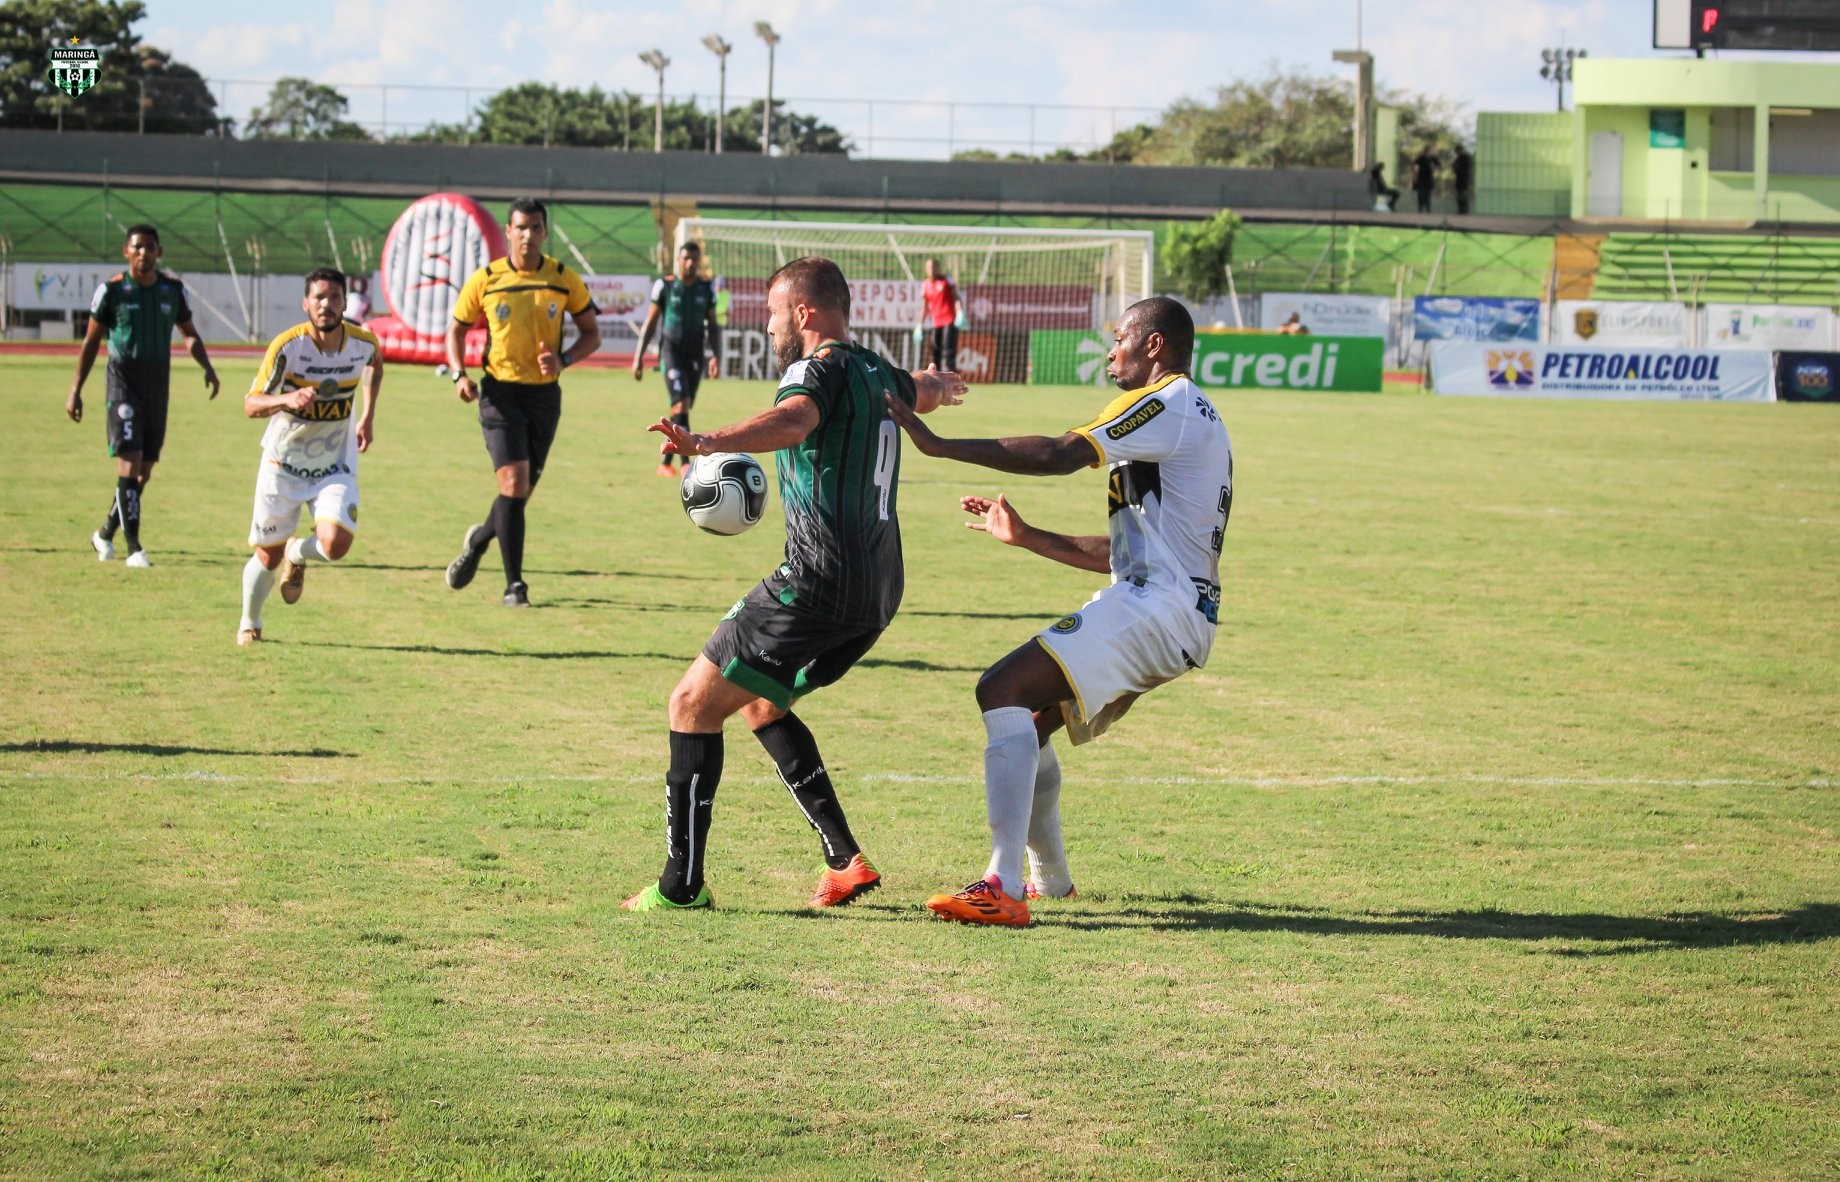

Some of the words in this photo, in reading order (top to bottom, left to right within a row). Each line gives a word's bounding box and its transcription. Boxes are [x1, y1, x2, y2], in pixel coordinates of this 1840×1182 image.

[1541, 352, 1721, 381] PETROALCOOL
[123, 420, 133, 441] 5
[1109, 401, 1163, 438] COOPAVEL
[874, 419, 897, 521] 9
